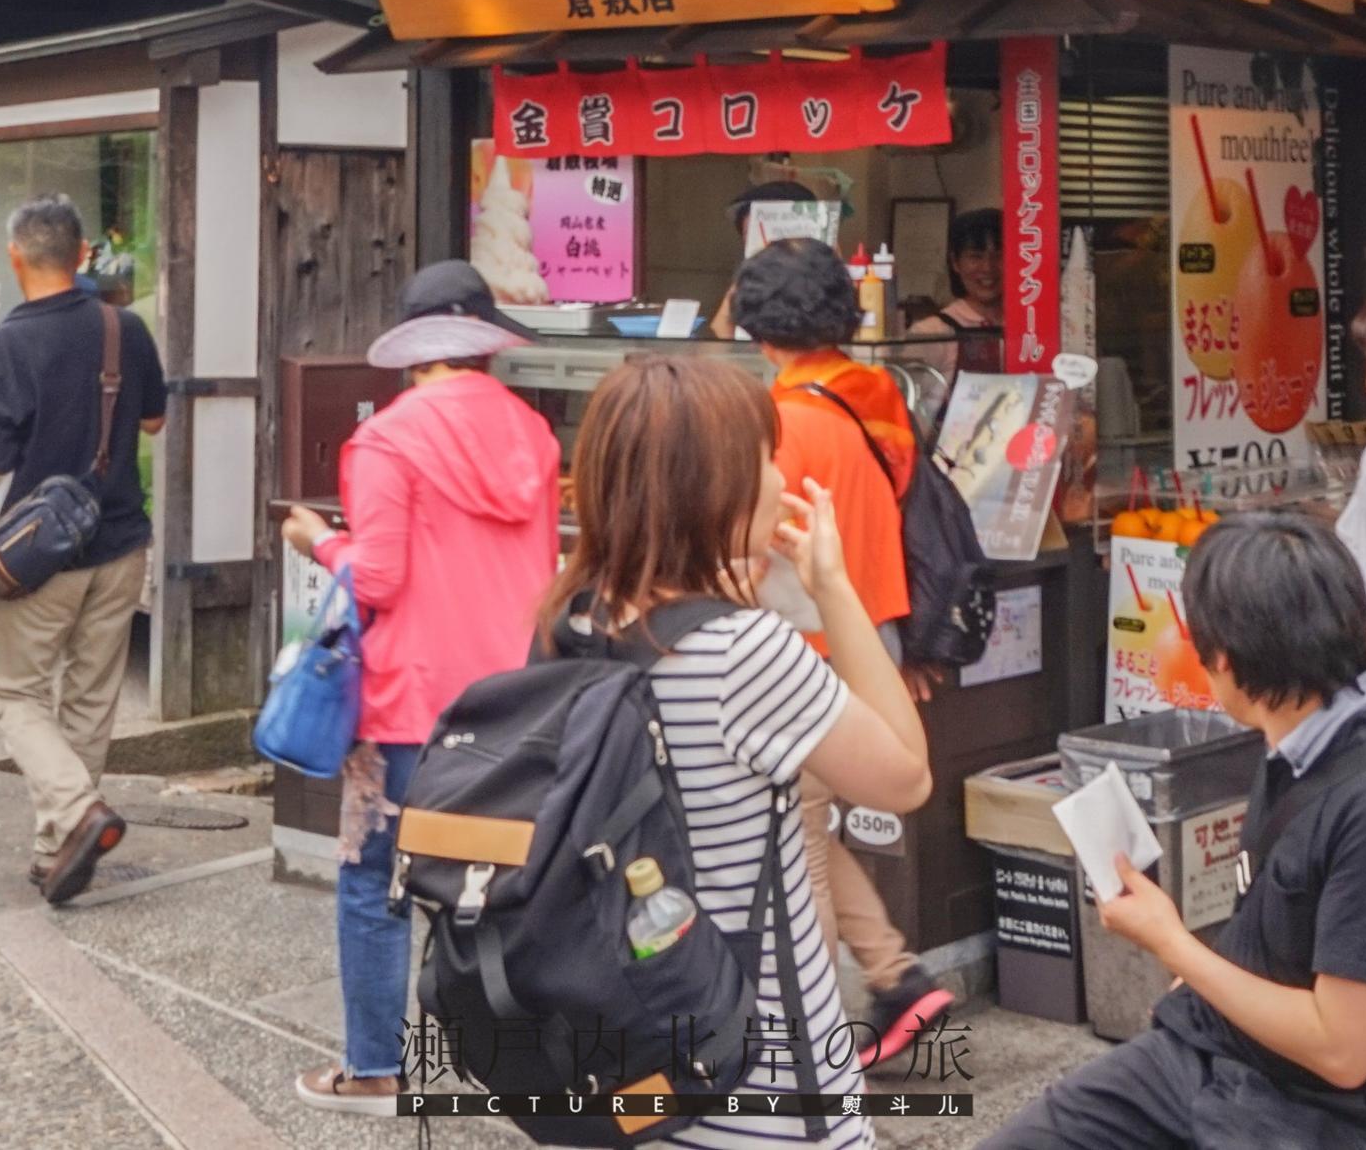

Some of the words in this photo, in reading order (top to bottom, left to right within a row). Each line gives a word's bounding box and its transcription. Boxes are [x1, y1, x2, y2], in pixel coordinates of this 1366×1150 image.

[511, 82, 922, 148] 金賞コロッケ
[1180, 69, 1230, 109] Pure
[1016, 67, 1045, 364] 全国コロッケコンクール
[1327, 225, 1344, 313] whole
[1182, 299, 1241, 353] まるごと
[1329, 321, 1345, 382] fruit
[1119, 546, 1156, 567] Pure
[1115, 649, 1160, 677] まるごと
[851, 812, 897, 837] 350円
